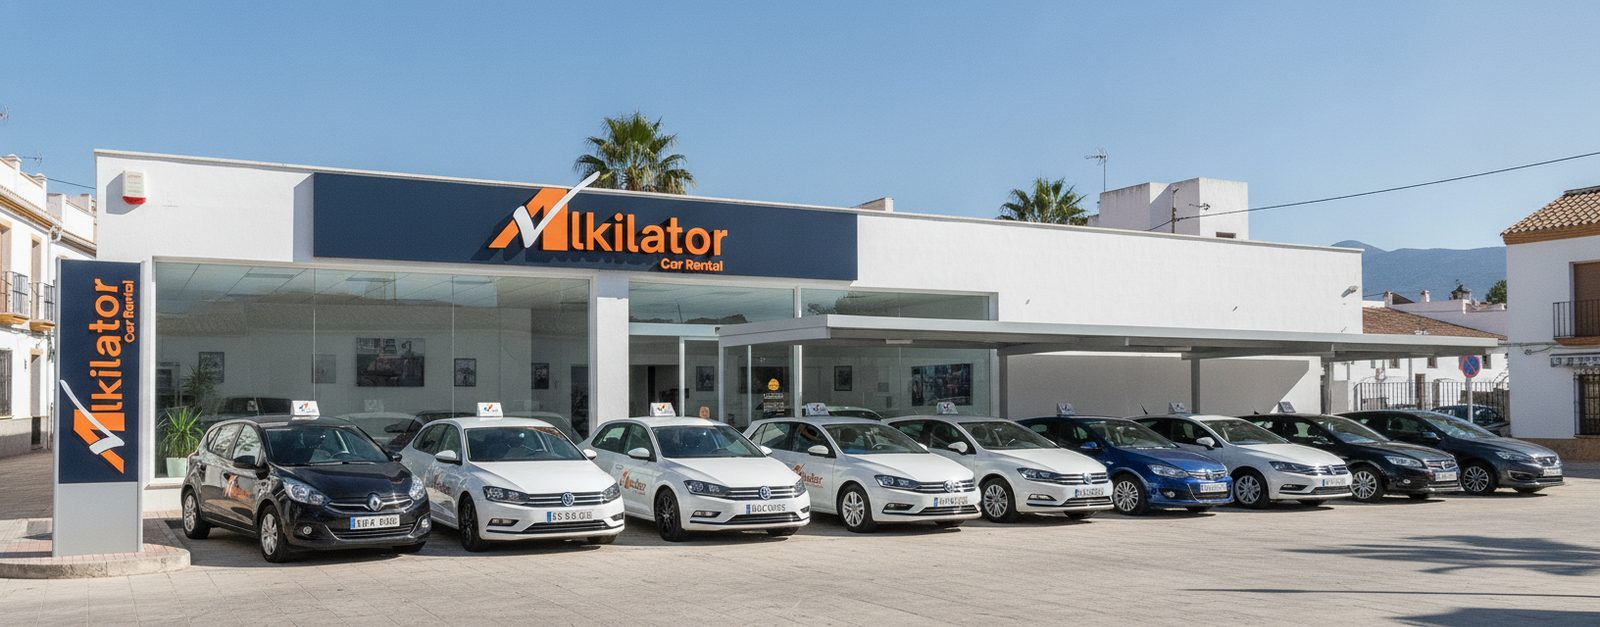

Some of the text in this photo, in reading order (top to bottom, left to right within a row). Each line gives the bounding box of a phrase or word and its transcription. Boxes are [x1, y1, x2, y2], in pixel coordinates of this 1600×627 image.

[489, 186, 728, 256] Alkilator
[661, 258, 723, 272] Car Rental
[73, 278, 125, 473] Alkilator
